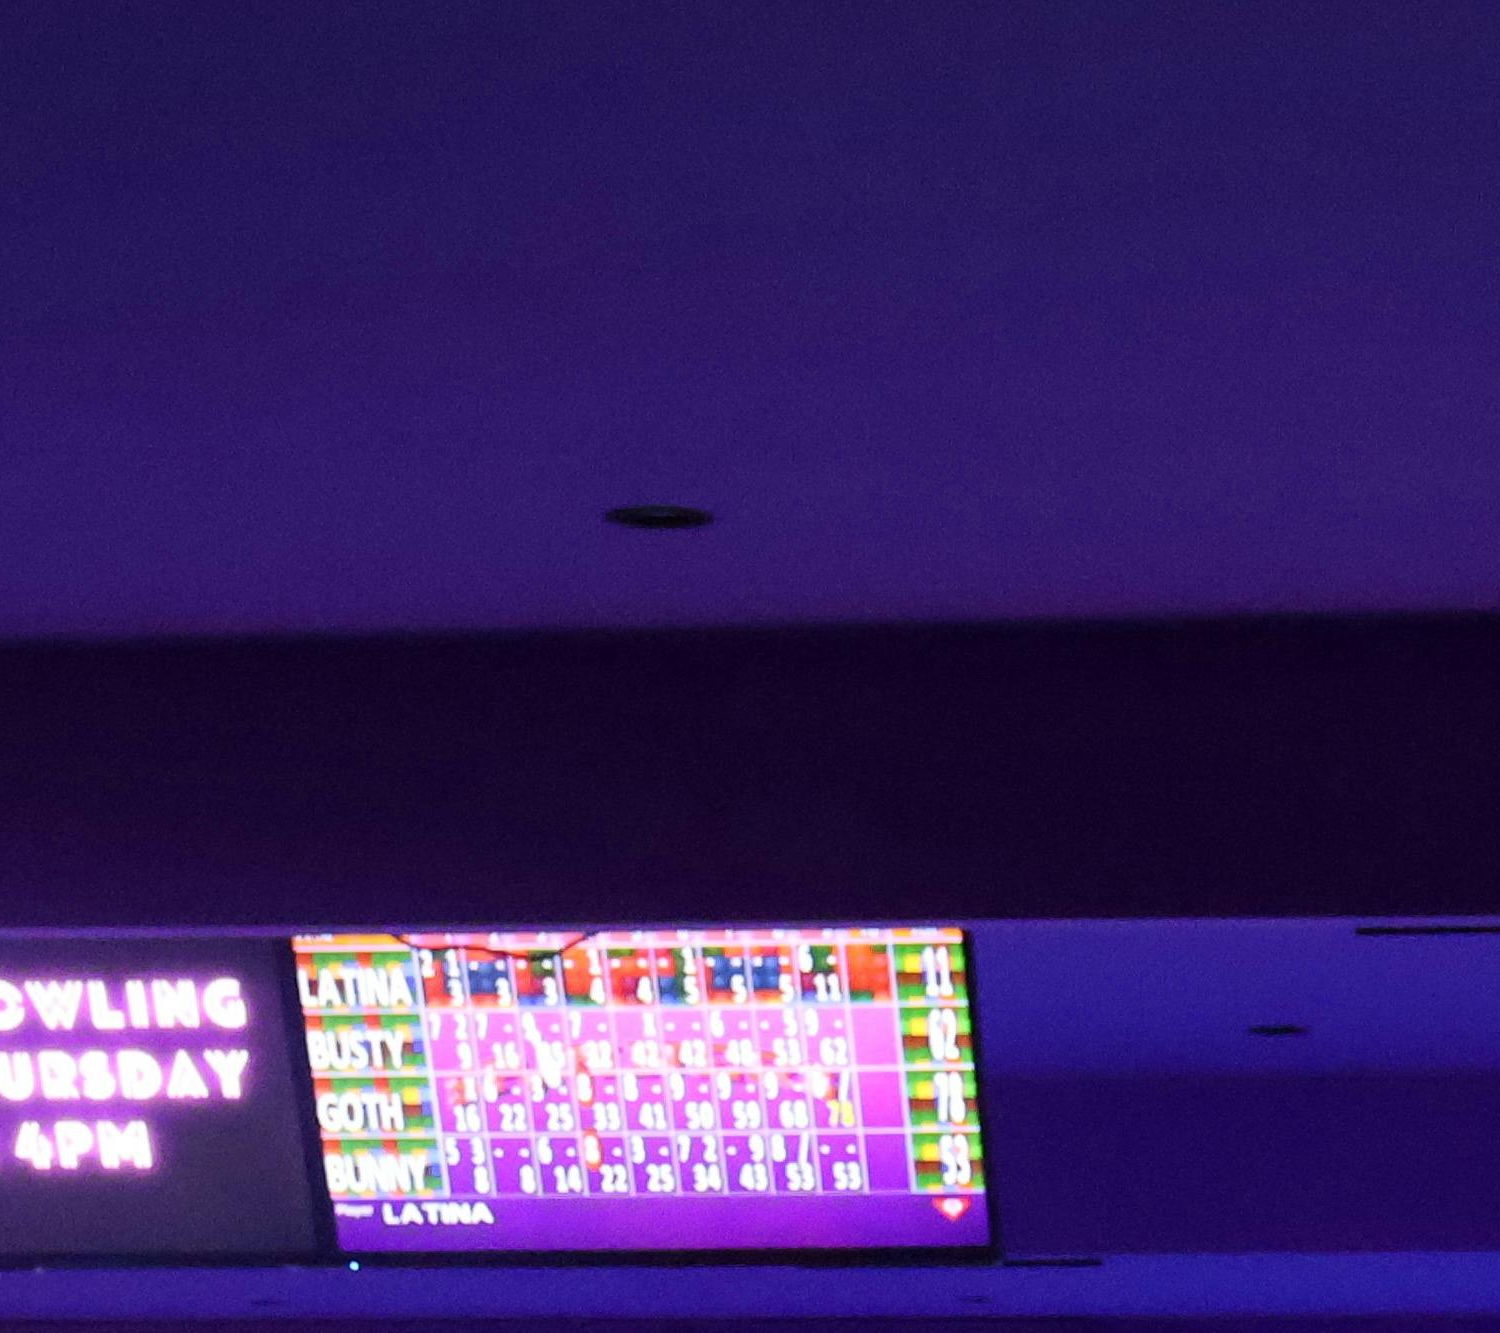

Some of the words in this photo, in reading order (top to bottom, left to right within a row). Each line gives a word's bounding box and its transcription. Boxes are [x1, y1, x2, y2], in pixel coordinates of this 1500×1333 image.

[299, 966, 412, 1006] LATINA
[307, 1031, 404, 1070] BUSTY
[318, 1092, 404, 1131] GOTH
[500, 1104, 526, 1131] 22
[547, 1104, 574, 1131] 25
[13, 1119, 154, 1171] 4PM
[326, 1154, 427, 1193] BUNNY
[601, 1165, 628, 1192] 22
[834, 1162, 861, 1190] 53
[383, 1203, 493, 1224] LATINA
